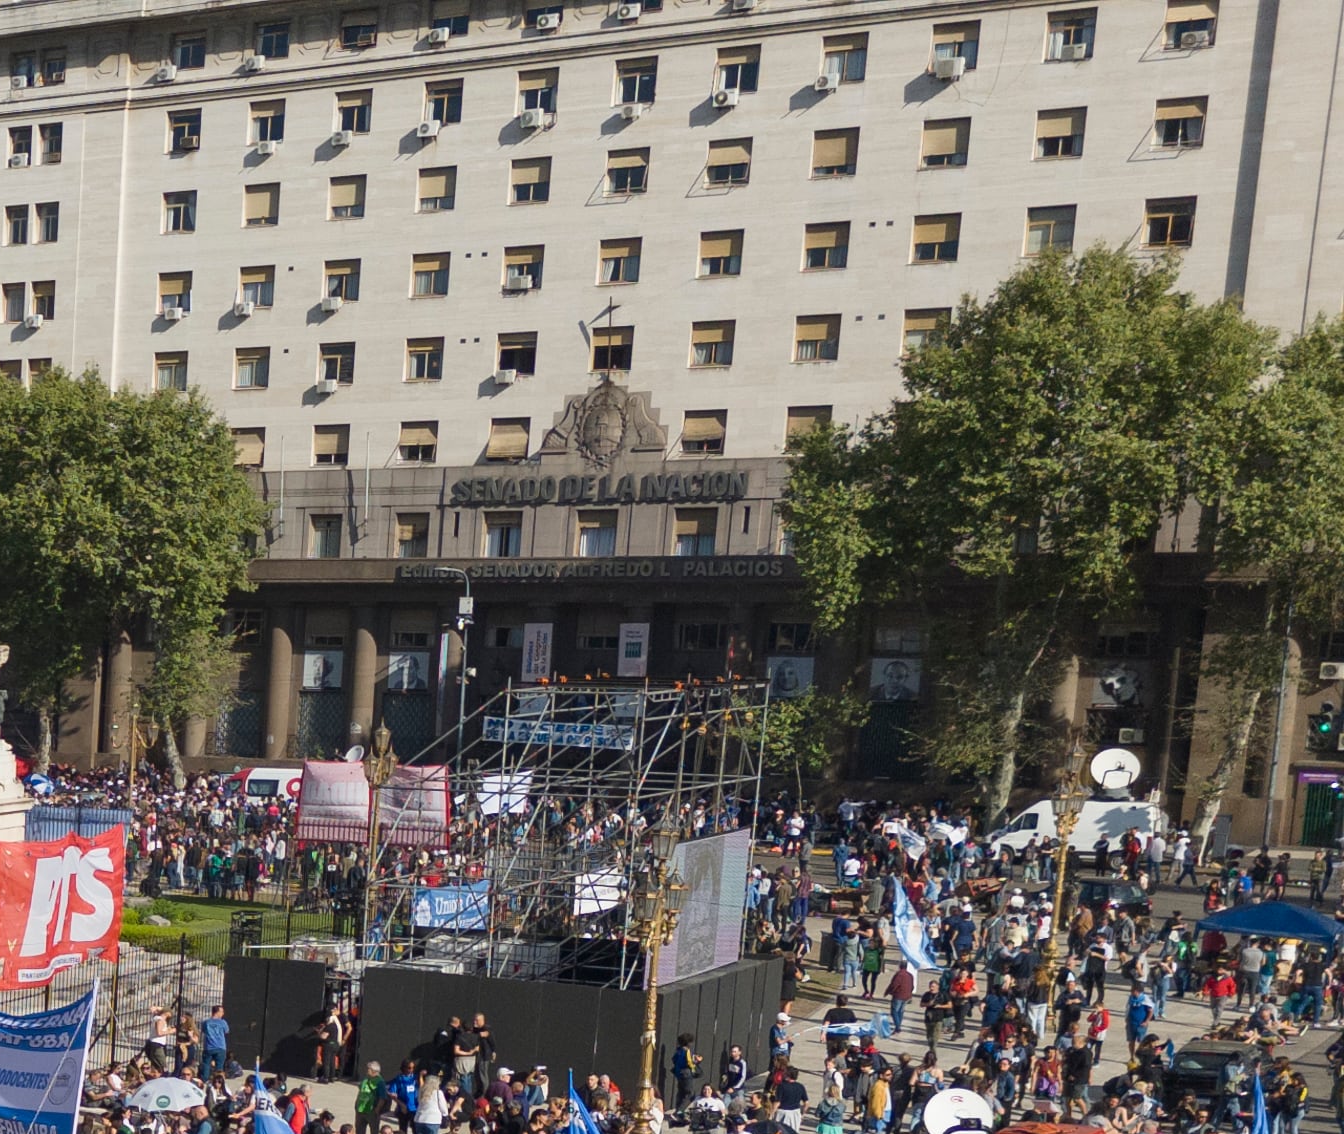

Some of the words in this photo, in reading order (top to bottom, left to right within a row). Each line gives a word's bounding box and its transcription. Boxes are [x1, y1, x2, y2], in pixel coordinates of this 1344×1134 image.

[454, 473, 557, 502] SENADO
[564, 472, 595, 501] DE
[606, 472, 638, 500] LA
[470, 563, 560, 580] SENADOR
[563, 561, 652, 579] ALFREDO
[682, 559, 784, 578] PALACIOS
